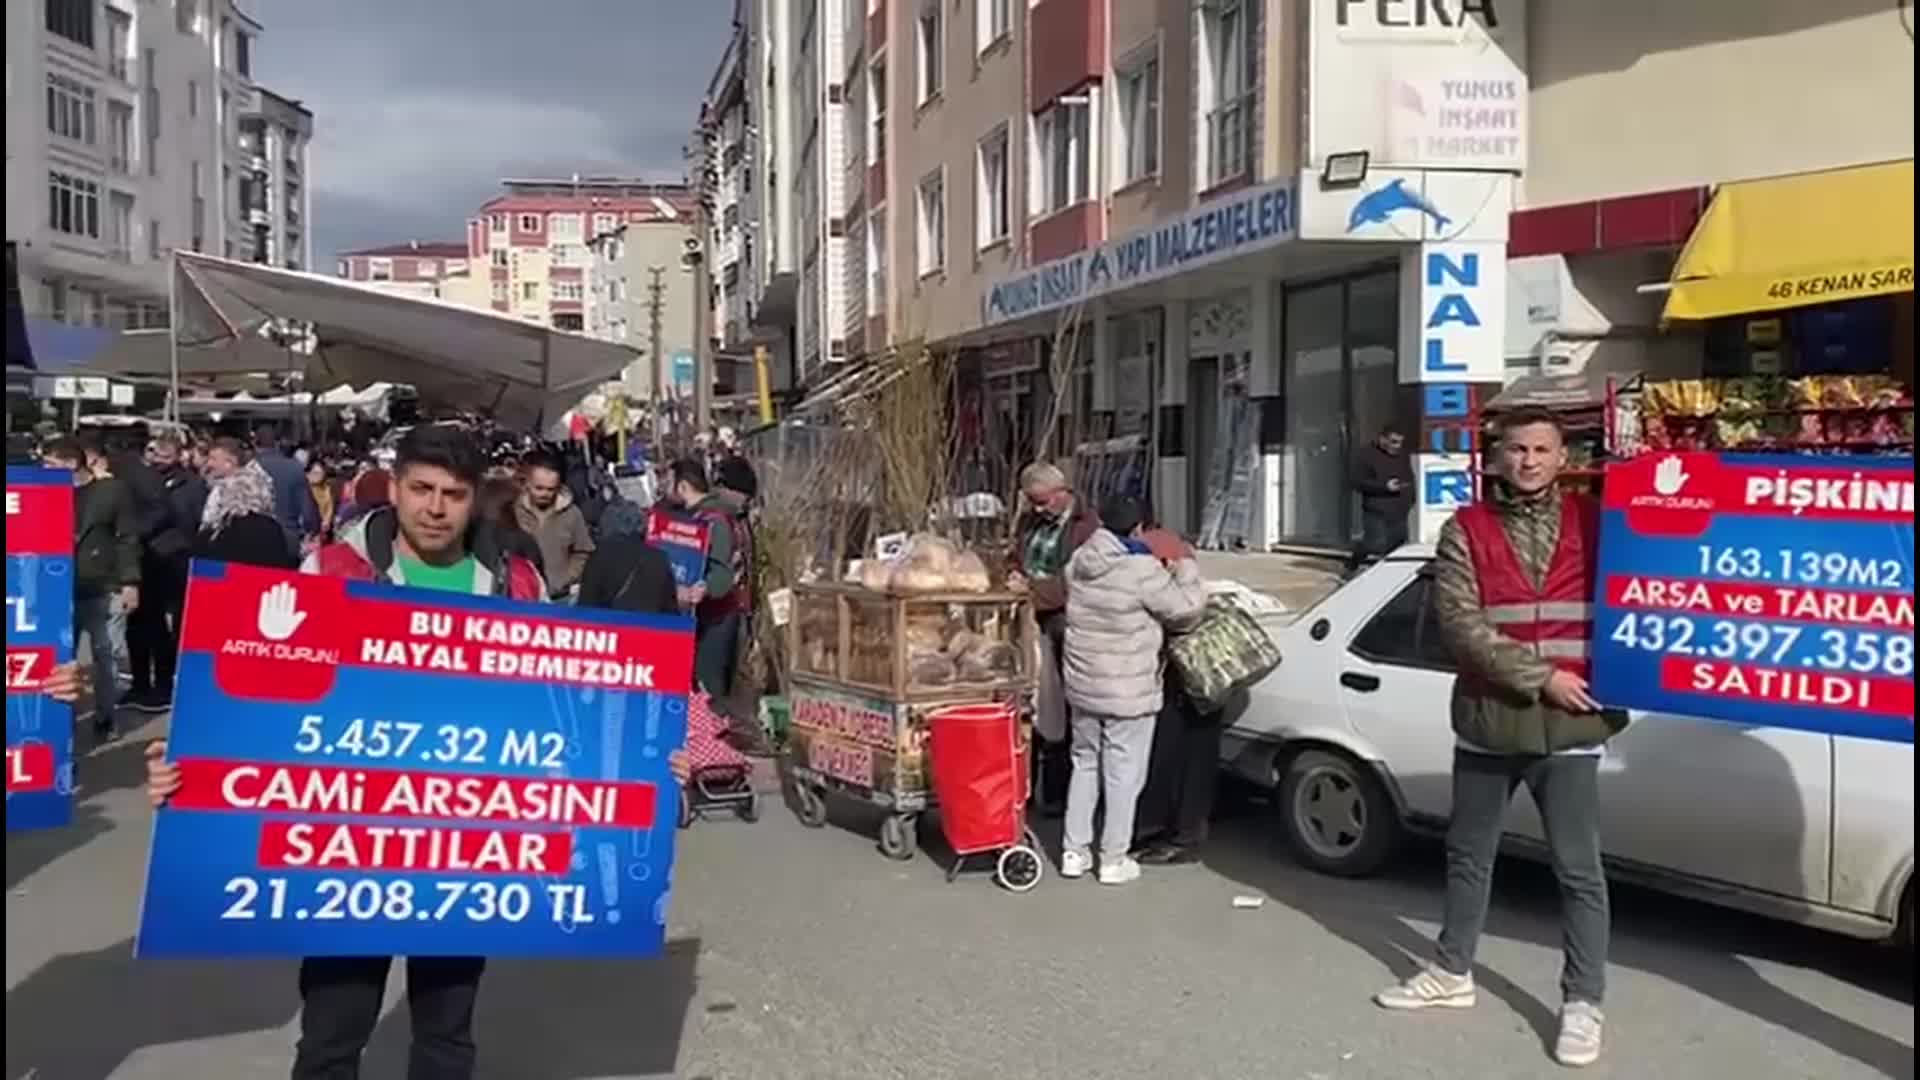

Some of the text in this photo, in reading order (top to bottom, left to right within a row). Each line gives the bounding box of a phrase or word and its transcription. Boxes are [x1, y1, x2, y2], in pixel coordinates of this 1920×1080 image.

[1440, 79, 1516, 100] YUNUS
[1116, 235, 1152, 281] YAPI
[1796, 271, 1867, 297] KENAN
[1868, 267, 1914, 290] ŞAR
[1620, 577, 1713, 609] ARSA
[1724, 593, 1764, 614] ve
[220, 639, 340, 665] ARTIK DURUN!
[409, 611, 619, 653] BU KADARINI
[1611, 612, 1912, 675] 432.397.358
[361, 638, 655, 687] HAYAL EDEMEZDİK
[1692, 663, 1870, 708] SATILDI
[294, 715, 564, 768] 5.457.32 M2
[380, 775, 618, 823] ARSASINI
[282, 824, 547, 871] SATTILAR
[221, 876, 593, 922] 21.208.730 TL
